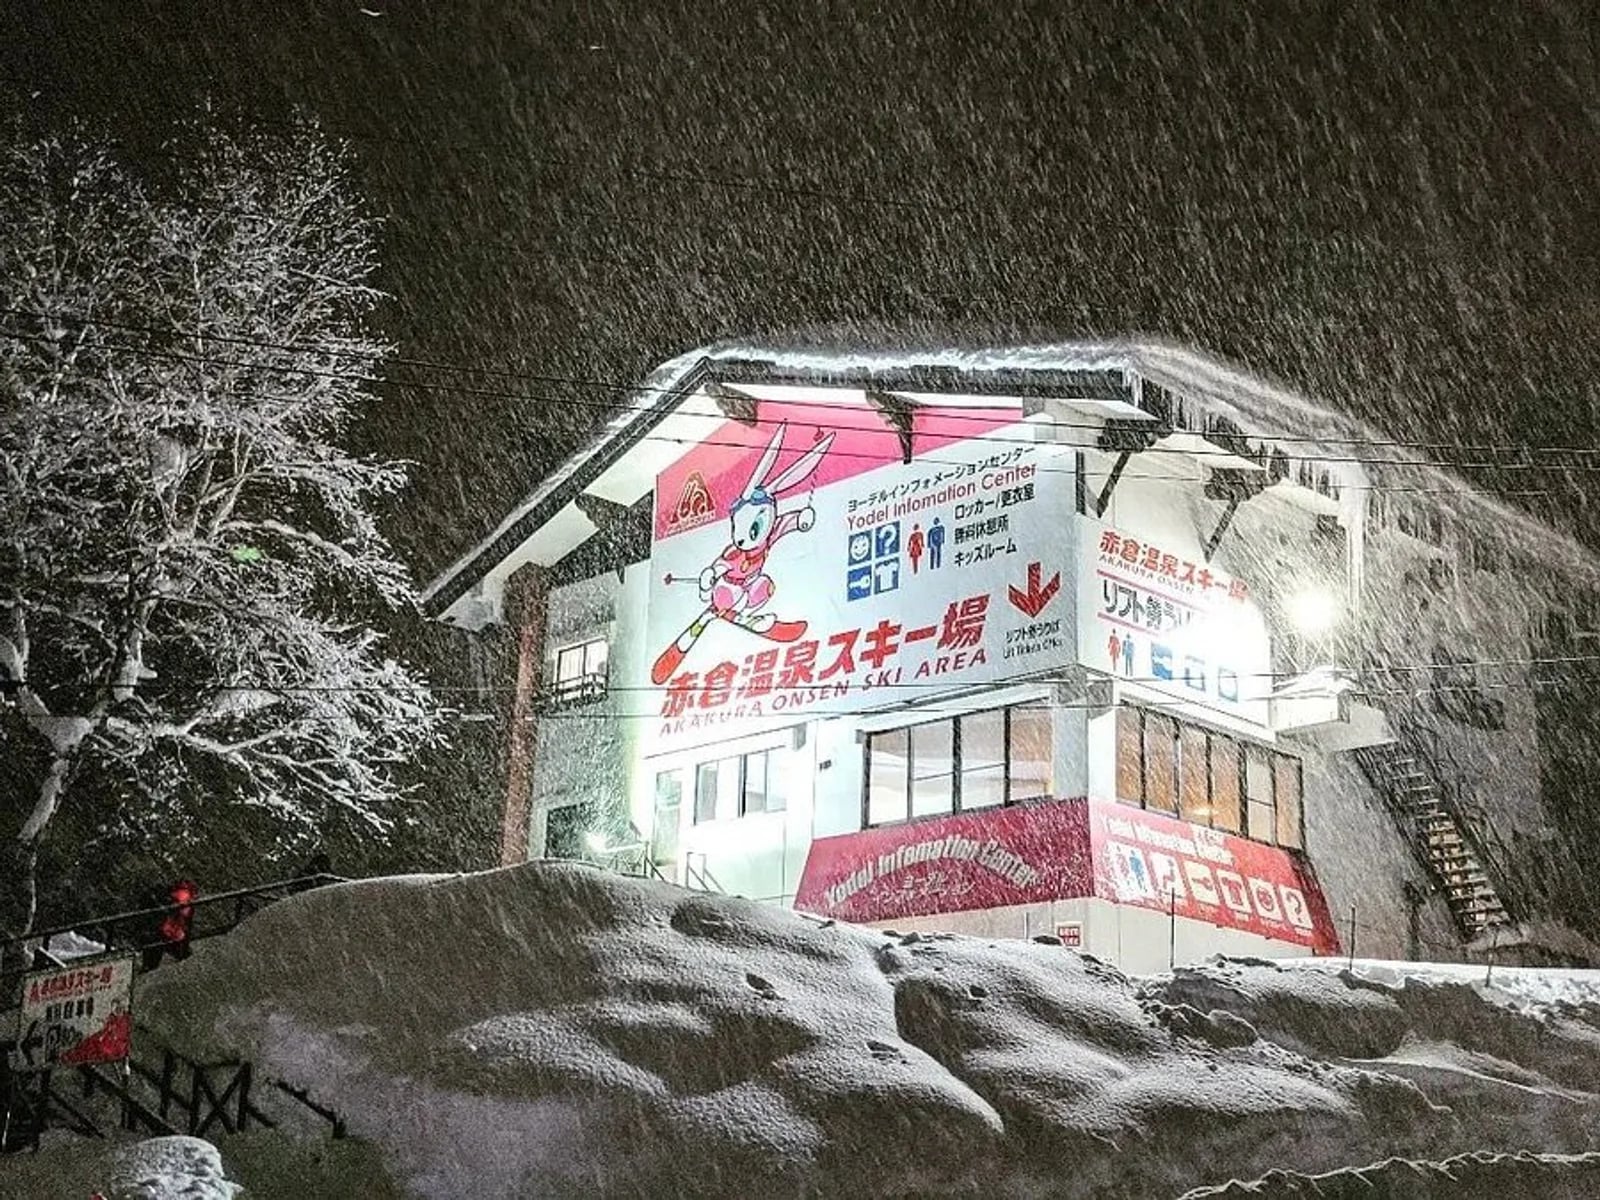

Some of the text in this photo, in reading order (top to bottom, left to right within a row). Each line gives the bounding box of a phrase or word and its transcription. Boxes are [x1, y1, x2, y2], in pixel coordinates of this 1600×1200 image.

[847, 463, 1037, 532] Yodel Infomation Center
[848, 447, 1036, 512] ヨーデルインフォメーションセンター
[954, 537, 1017, 567] キッズルーム
[1100, 530, 1250, 602] 赤倉温泉スキー場
[660, 594, 990, 718] 赤倉温泉スキー場
[659, 701, 763, 737] AKAKURA
[772, 680, 849, 711] ONSEN
[862, 667, 903, 691] SKI
[915, 648, 987, 679] AREA
